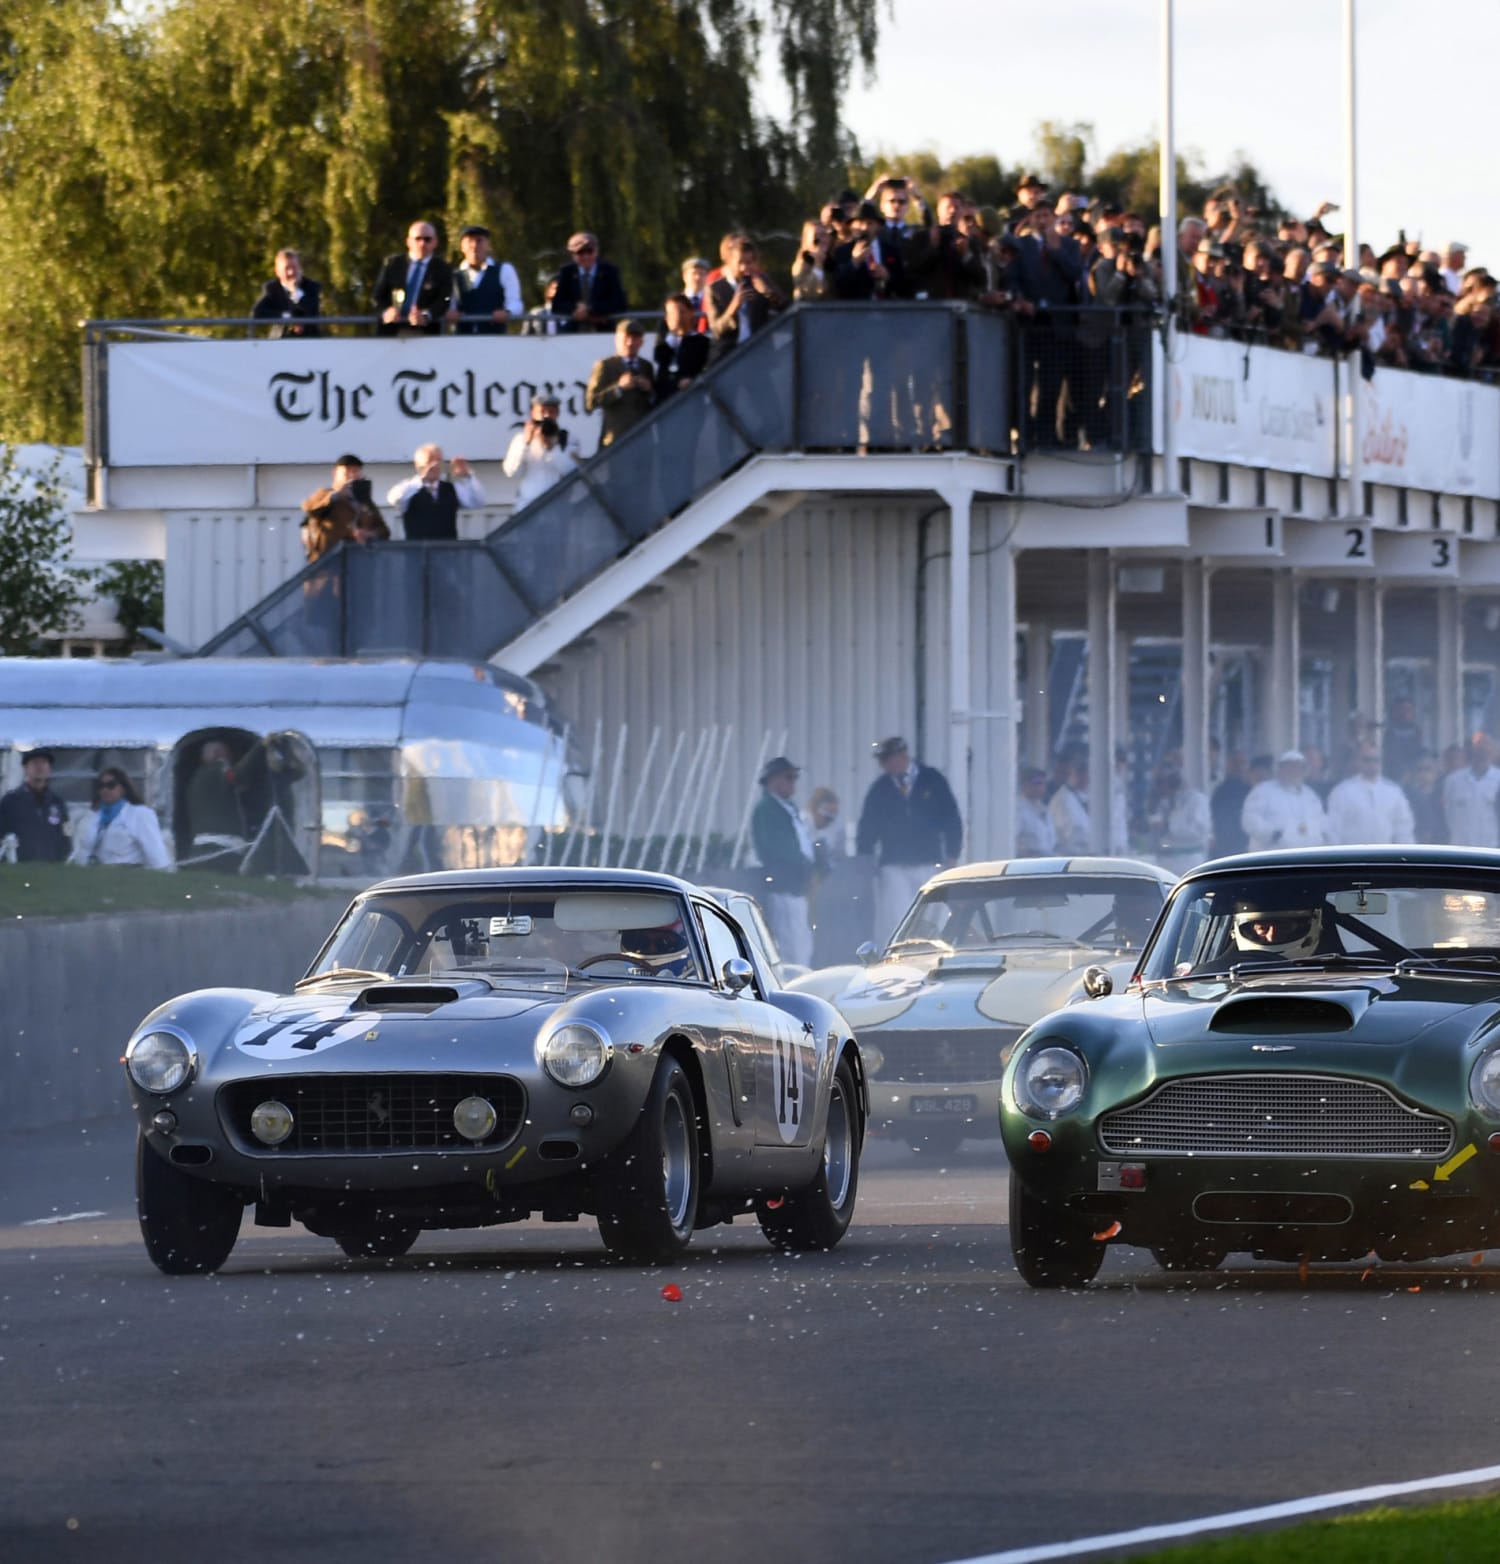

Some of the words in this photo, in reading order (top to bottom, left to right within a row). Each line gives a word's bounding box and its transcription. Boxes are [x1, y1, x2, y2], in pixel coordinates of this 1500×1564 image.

[269, 369, 374, 432] The
[1265, 517, 1273, 547] 1
[1346, 528, 1364, 557] 2
[1432, 539, 1450, 567] 3
[242, 1010, 367, 1050] 14
[775, 1022, 799, 1125] 14
